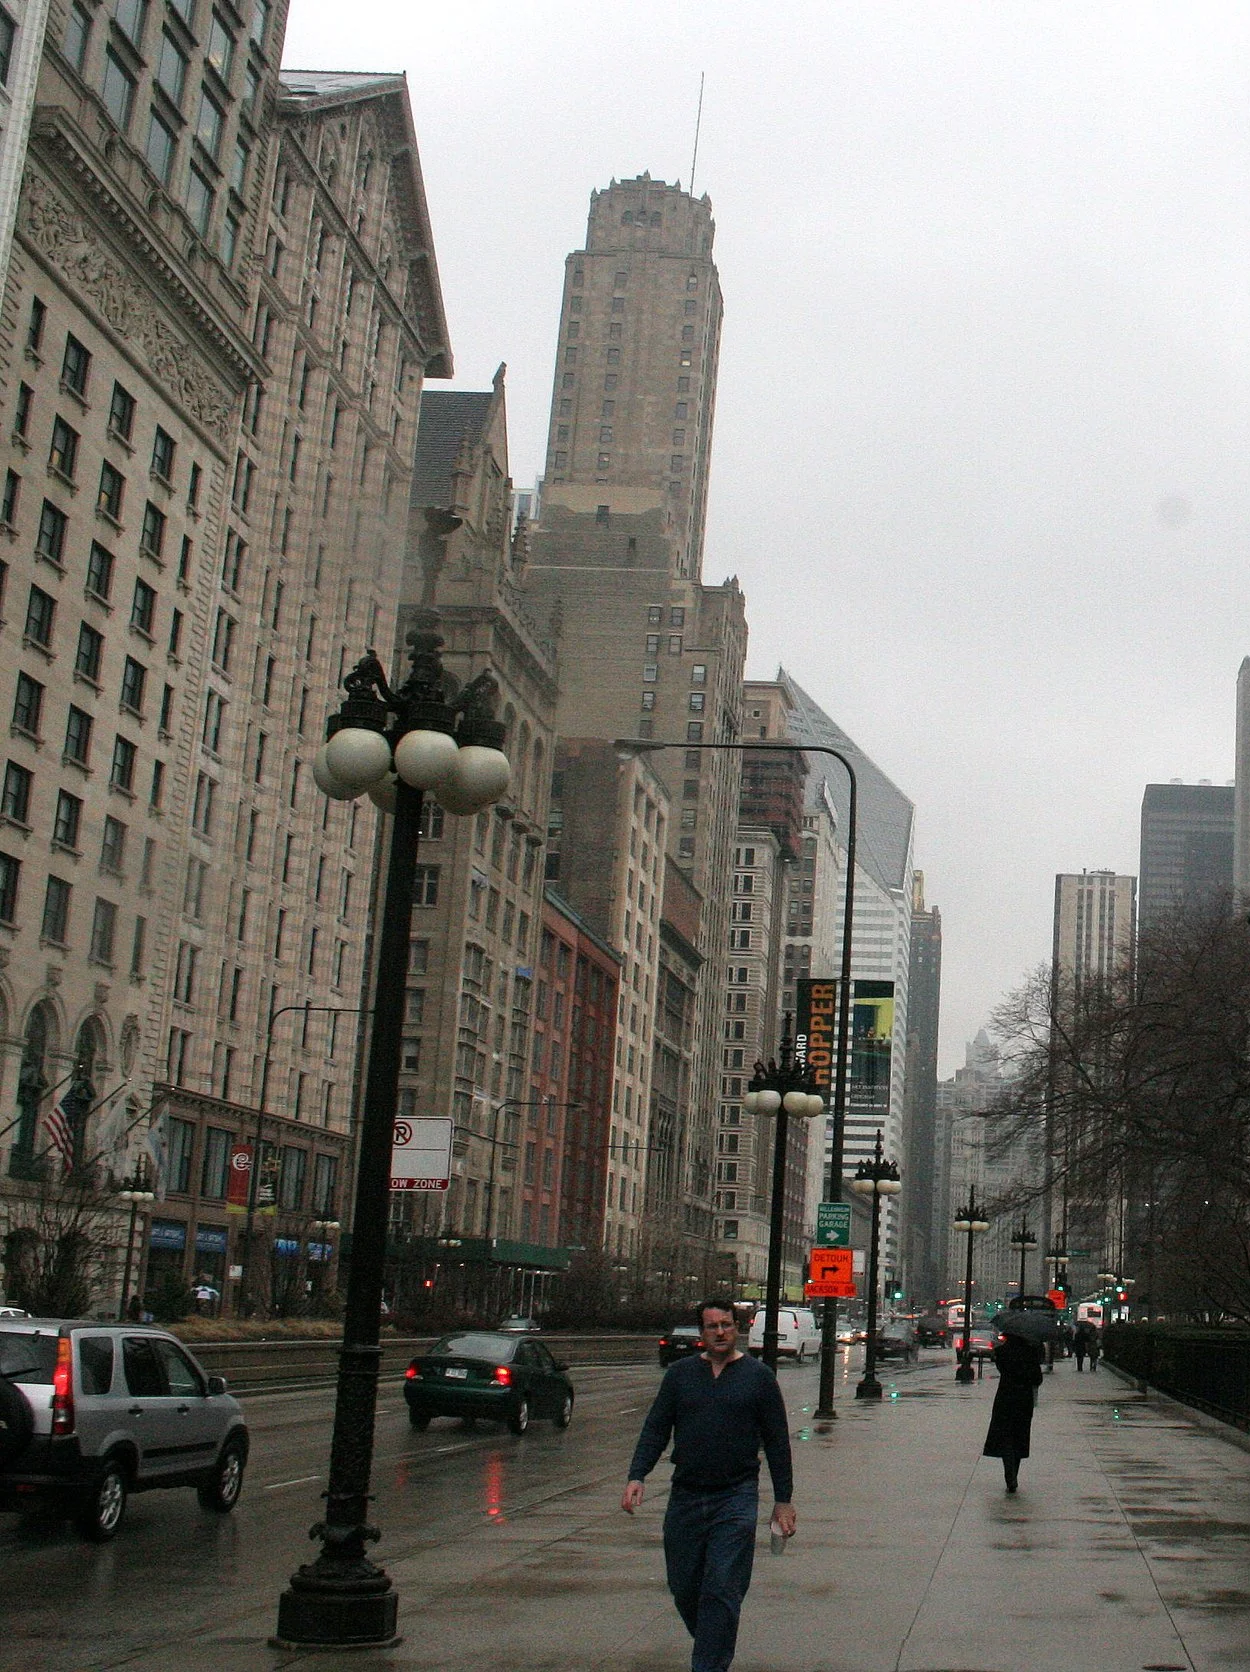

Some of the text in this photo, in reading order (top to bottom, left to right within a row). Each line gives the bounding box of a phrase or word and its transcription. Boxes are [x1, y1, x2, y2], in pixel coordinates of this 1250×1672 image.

[391, 1179, 442, 1189] OW ZONE
[819, 1212, 849, 1221] PARKING
[819, 1220, 849, 1229] GARAGE
[814, 1254, 849, 1262] DETOUR
